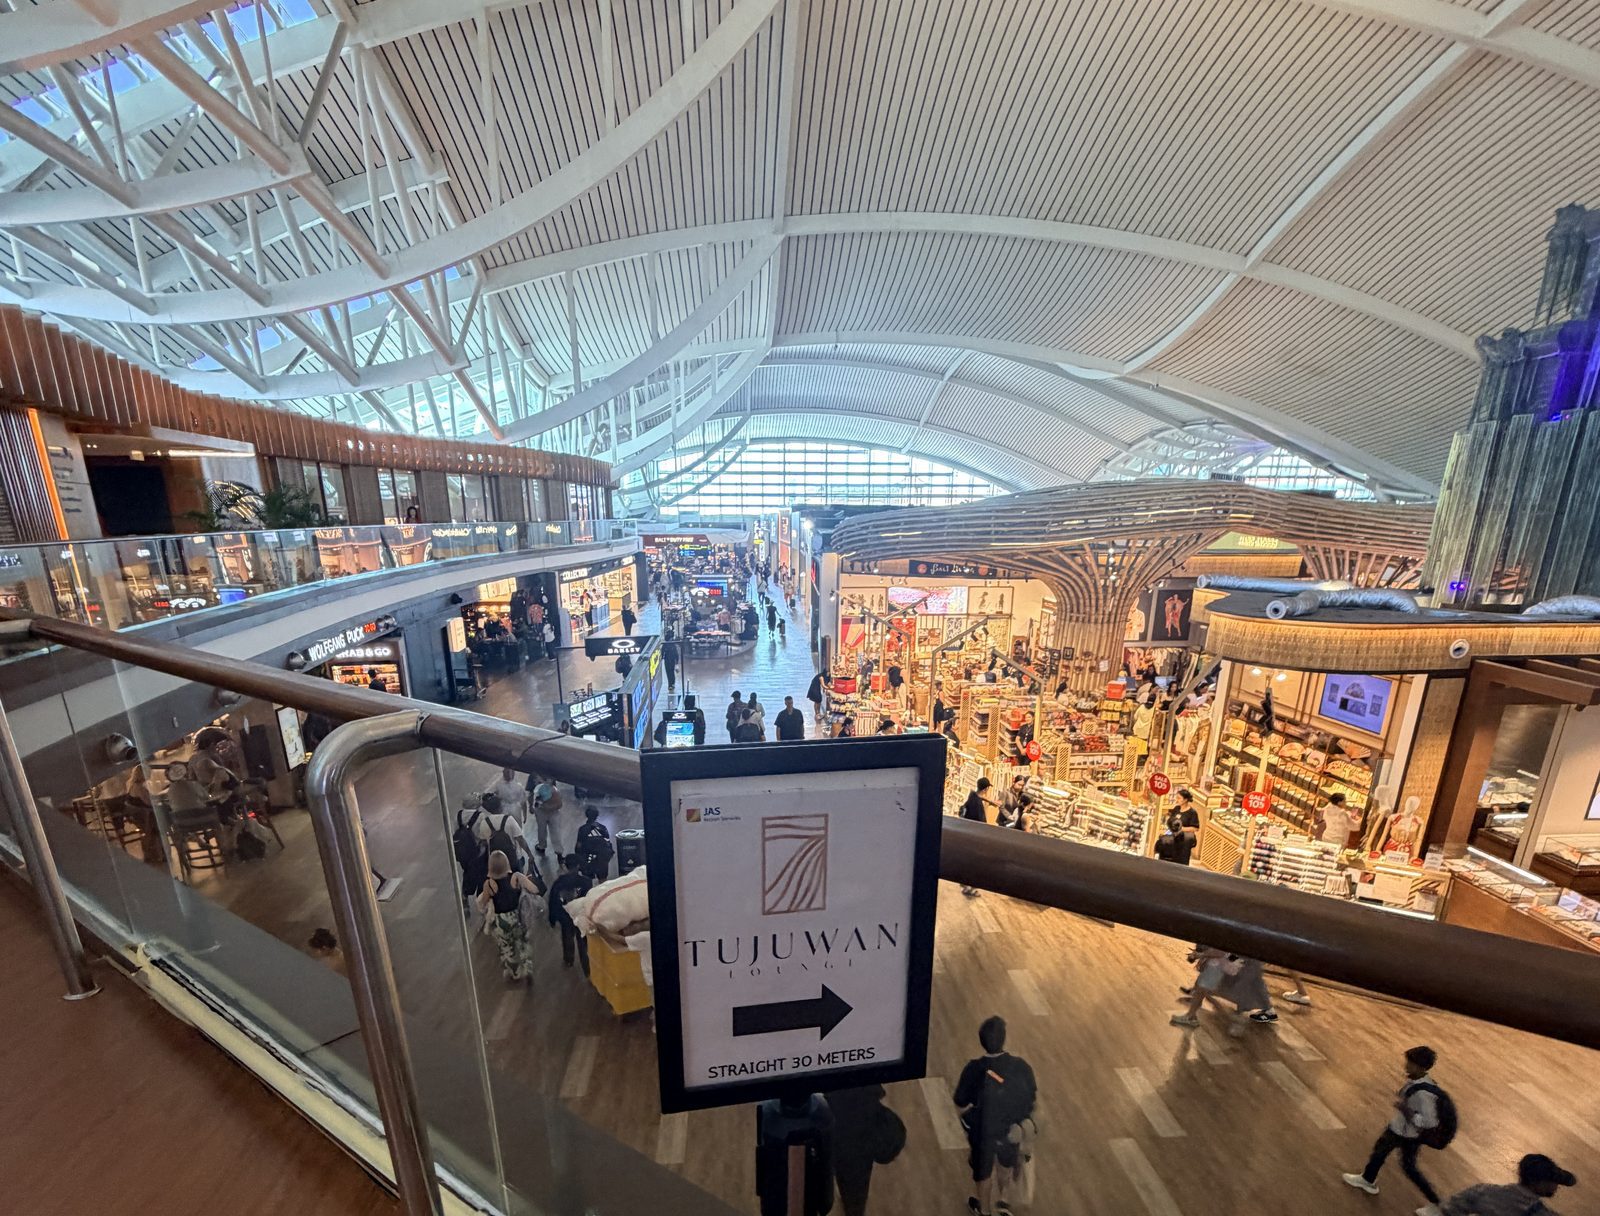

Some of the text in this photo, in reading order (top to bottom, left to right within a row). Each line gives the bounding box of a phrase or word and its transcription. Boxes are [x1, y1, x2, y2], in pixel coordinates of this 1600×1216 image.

[308, 633, 346, 661] WOLFGANG
[347, 626, 365, 644] PUCK
[374, 648, 391, 656] GO
[703, 807, 721, 816] JAS
[684, 922, 899, 967] TUJUWAN
[708, 1047, 876, 1079] STRAIGHT 30 METERS
